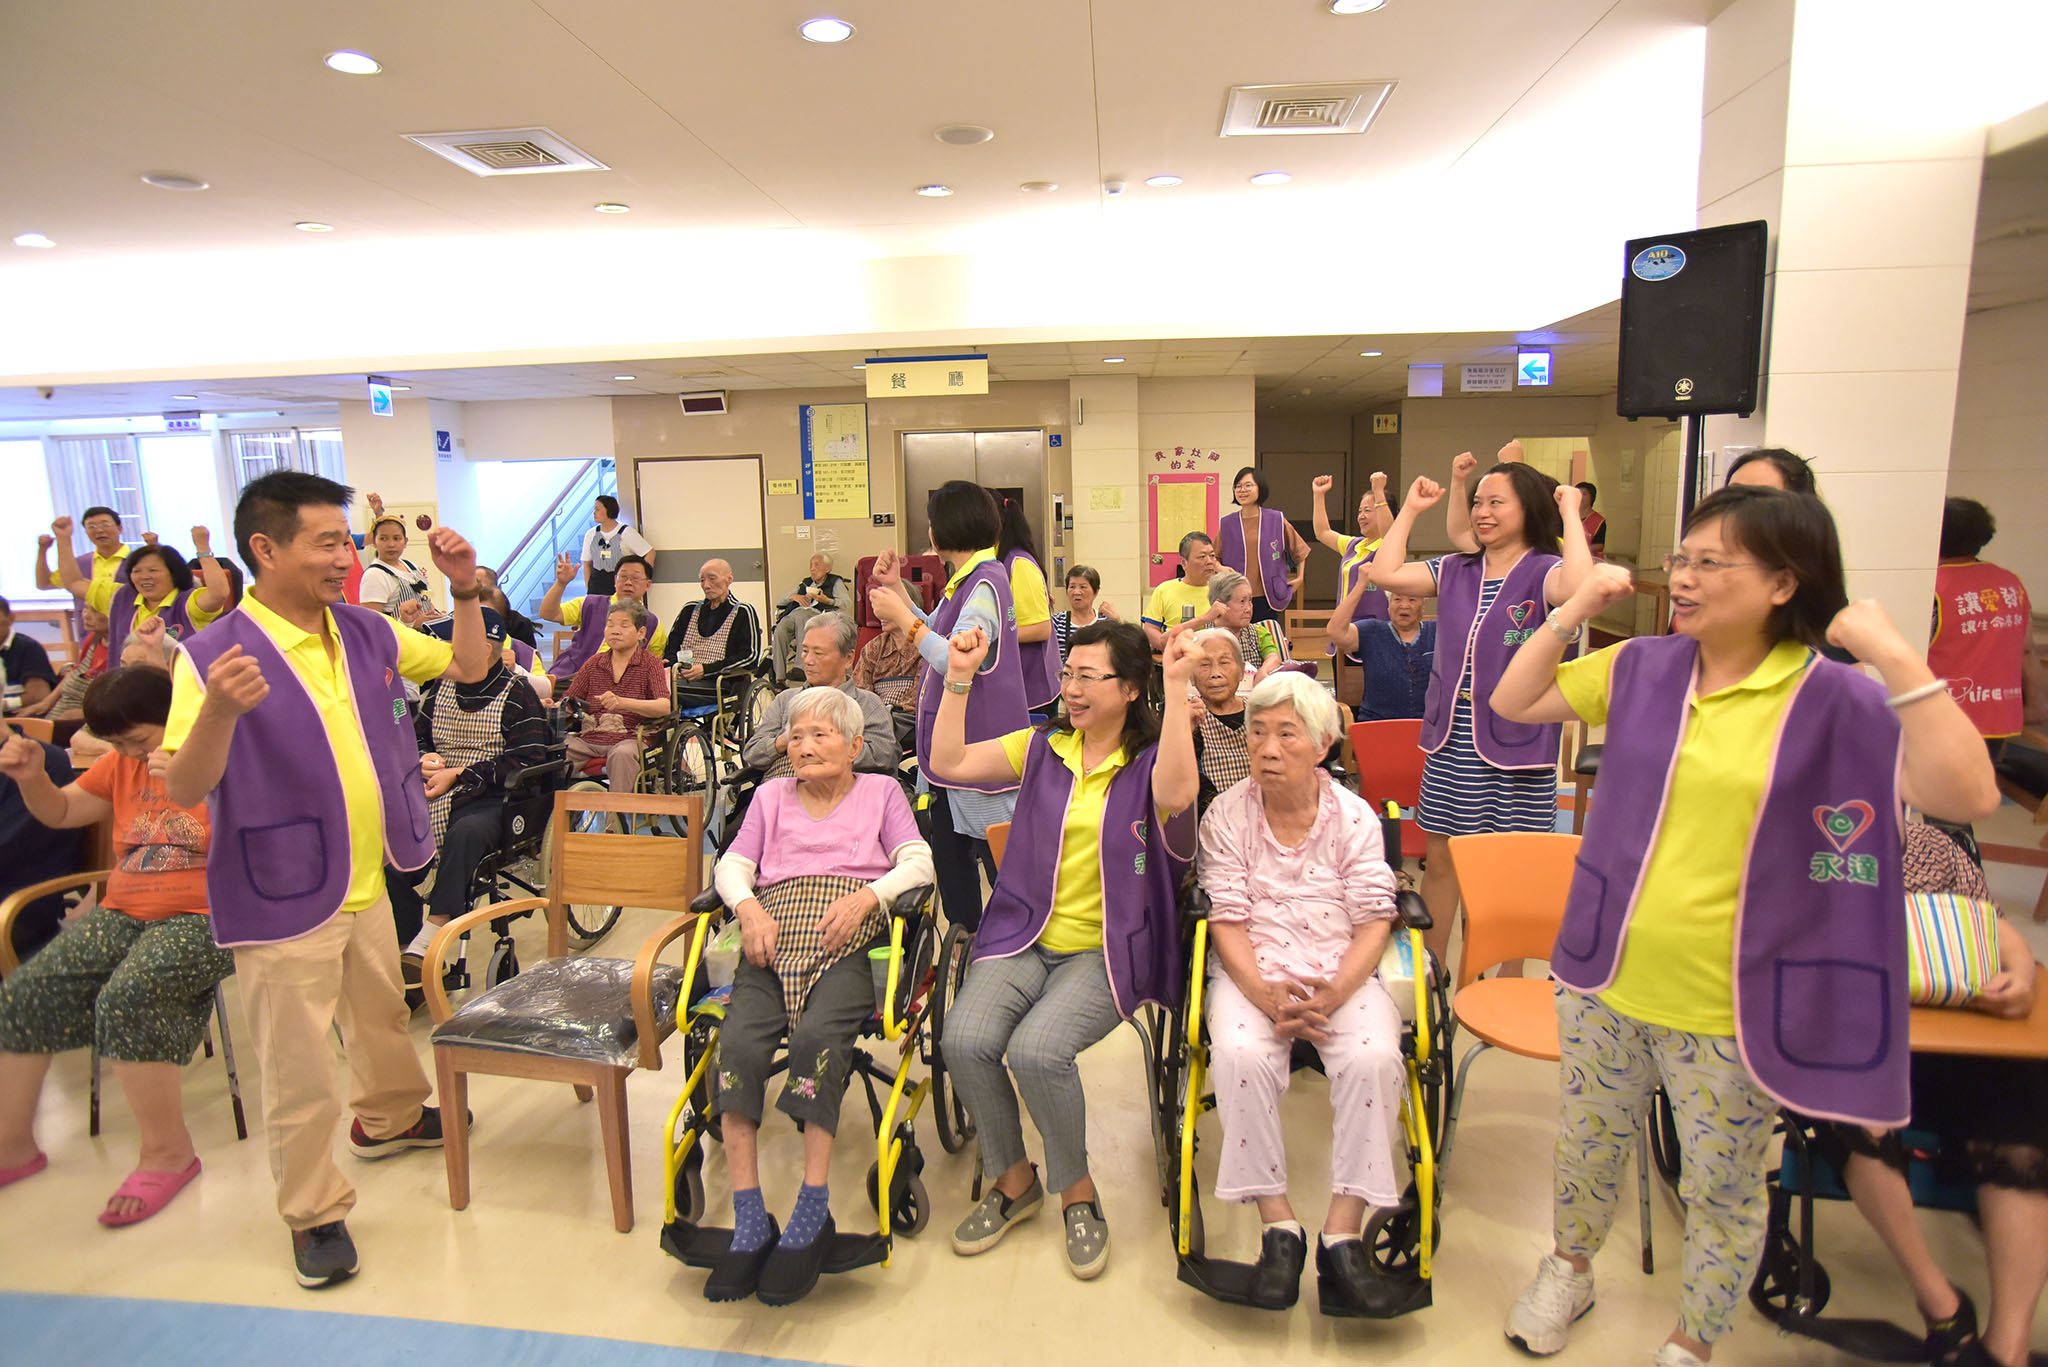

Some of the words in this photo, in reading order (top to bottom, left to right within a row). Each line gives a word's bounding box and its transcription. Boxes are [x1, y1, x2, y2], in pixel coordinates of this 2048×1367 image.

[891, 371, 964, 389] 餐廳
[873, 513, 894, 525] B1
[1808, 852, 1879, 888] 永達
[1074, 1222, 1086, 1238] 5
